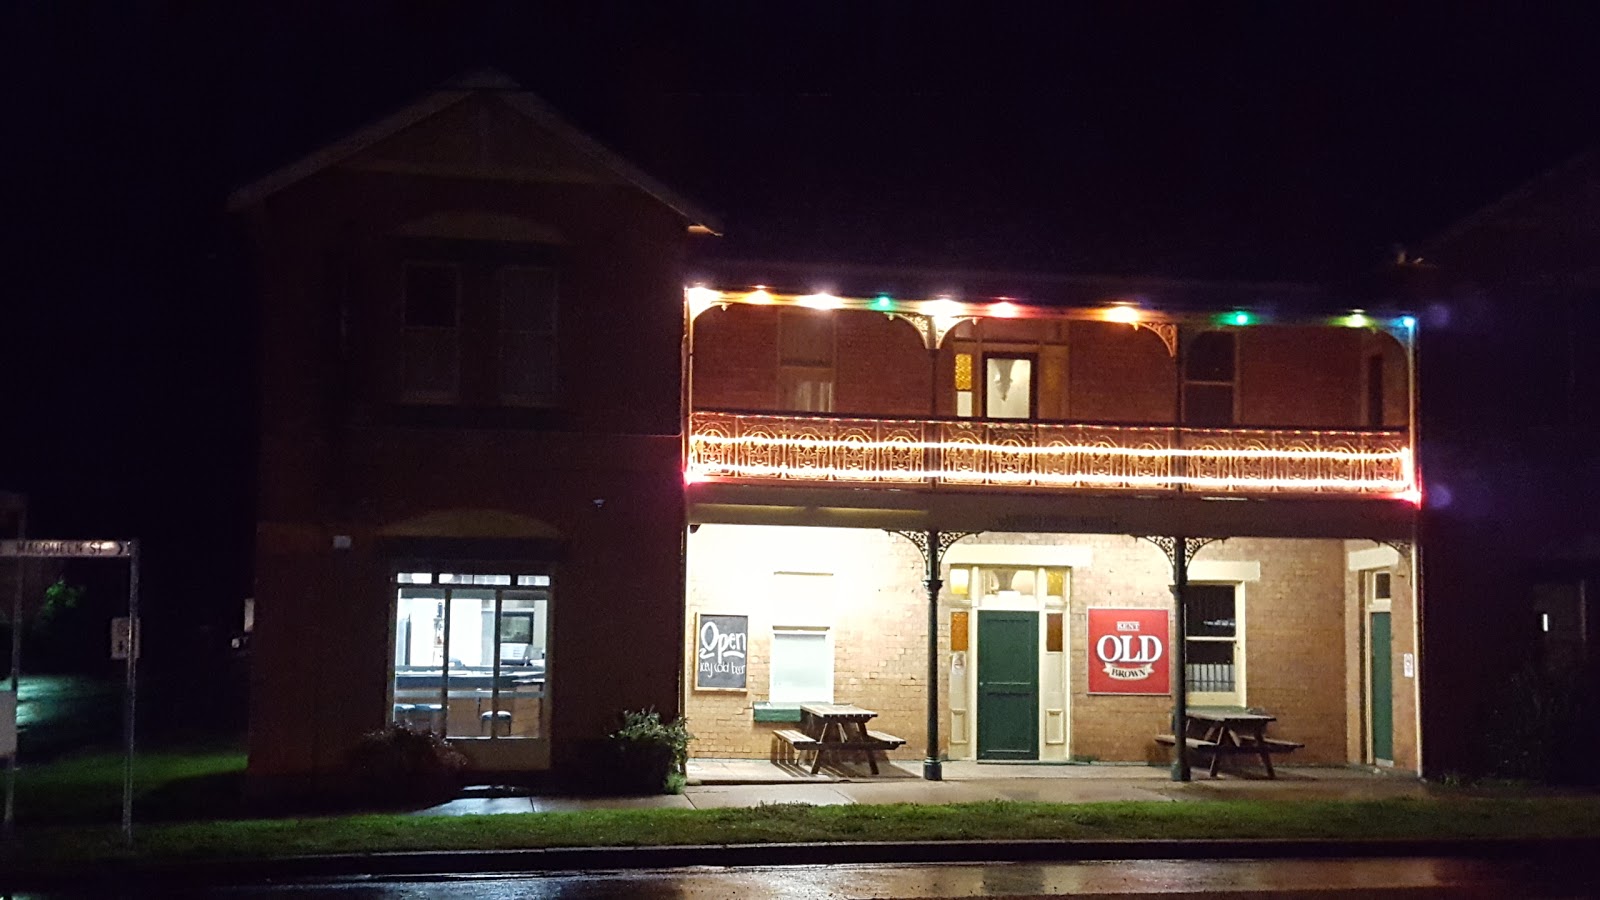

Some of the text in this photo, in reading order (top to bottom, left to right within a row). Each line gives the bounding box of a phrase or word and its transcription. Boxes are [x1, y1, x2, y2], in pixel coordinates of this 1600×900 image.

[700, 621, 746, 664] Open
[1096, 634, 1163, 662] OLD
[714, 662, 730, 673] cold
[731, 662, 746, 675] beer
[1110, 667, 1147, 678] BROWN
